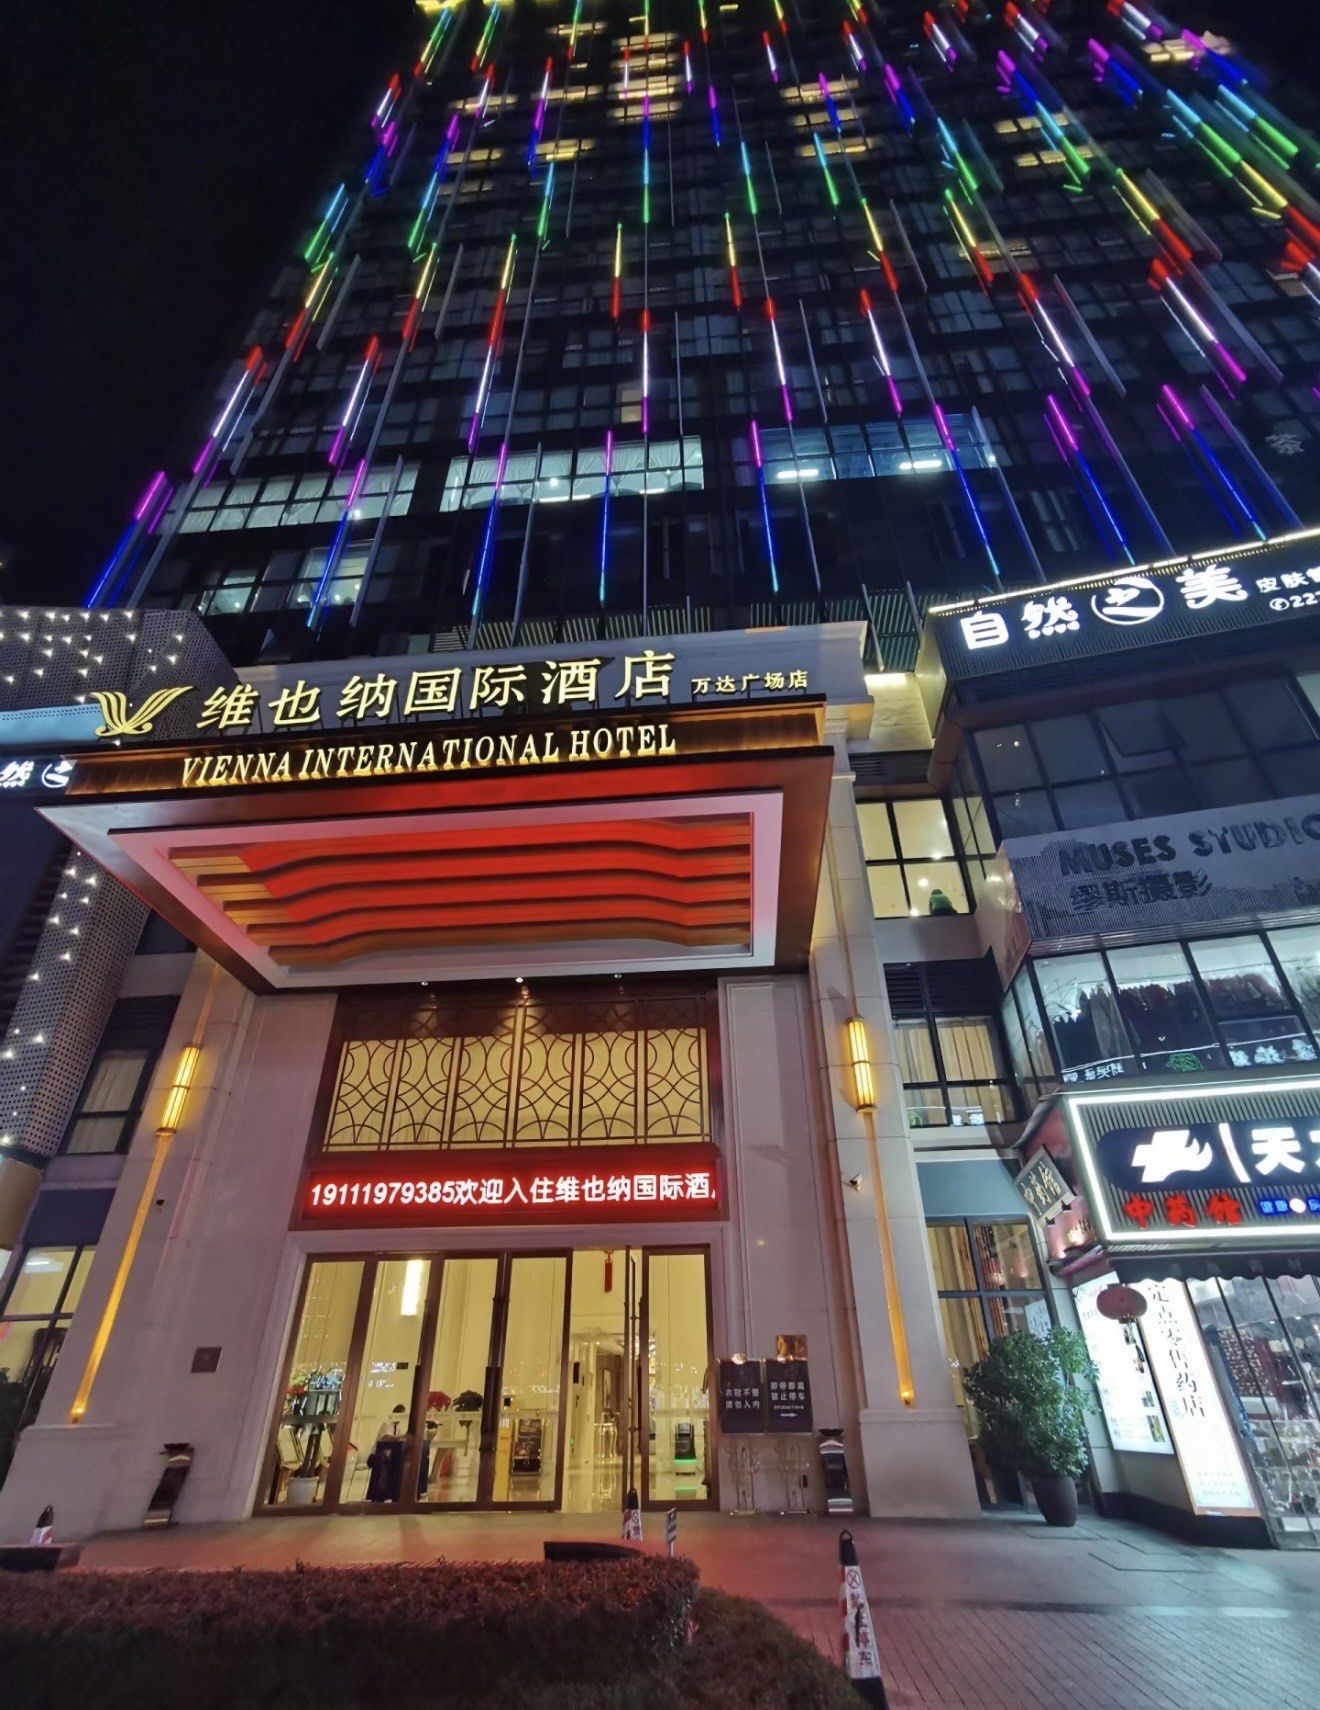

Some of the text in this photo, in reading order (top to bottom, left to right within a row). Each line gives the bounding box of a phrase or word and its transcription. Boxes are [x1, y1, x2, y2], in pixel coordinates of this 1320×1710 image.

[196, 650, 675, 731] 维也纳国际酒店
[691, 669, 808, 695] 万达广场店
[180, 724, 677, 788] VIENNA INTERNATIONAL HOTEL
[1059, 834, 1177, 876] MUSES
[311, 1172, 716, 1206] 19111979385欢迎入住维也纳国际酒
